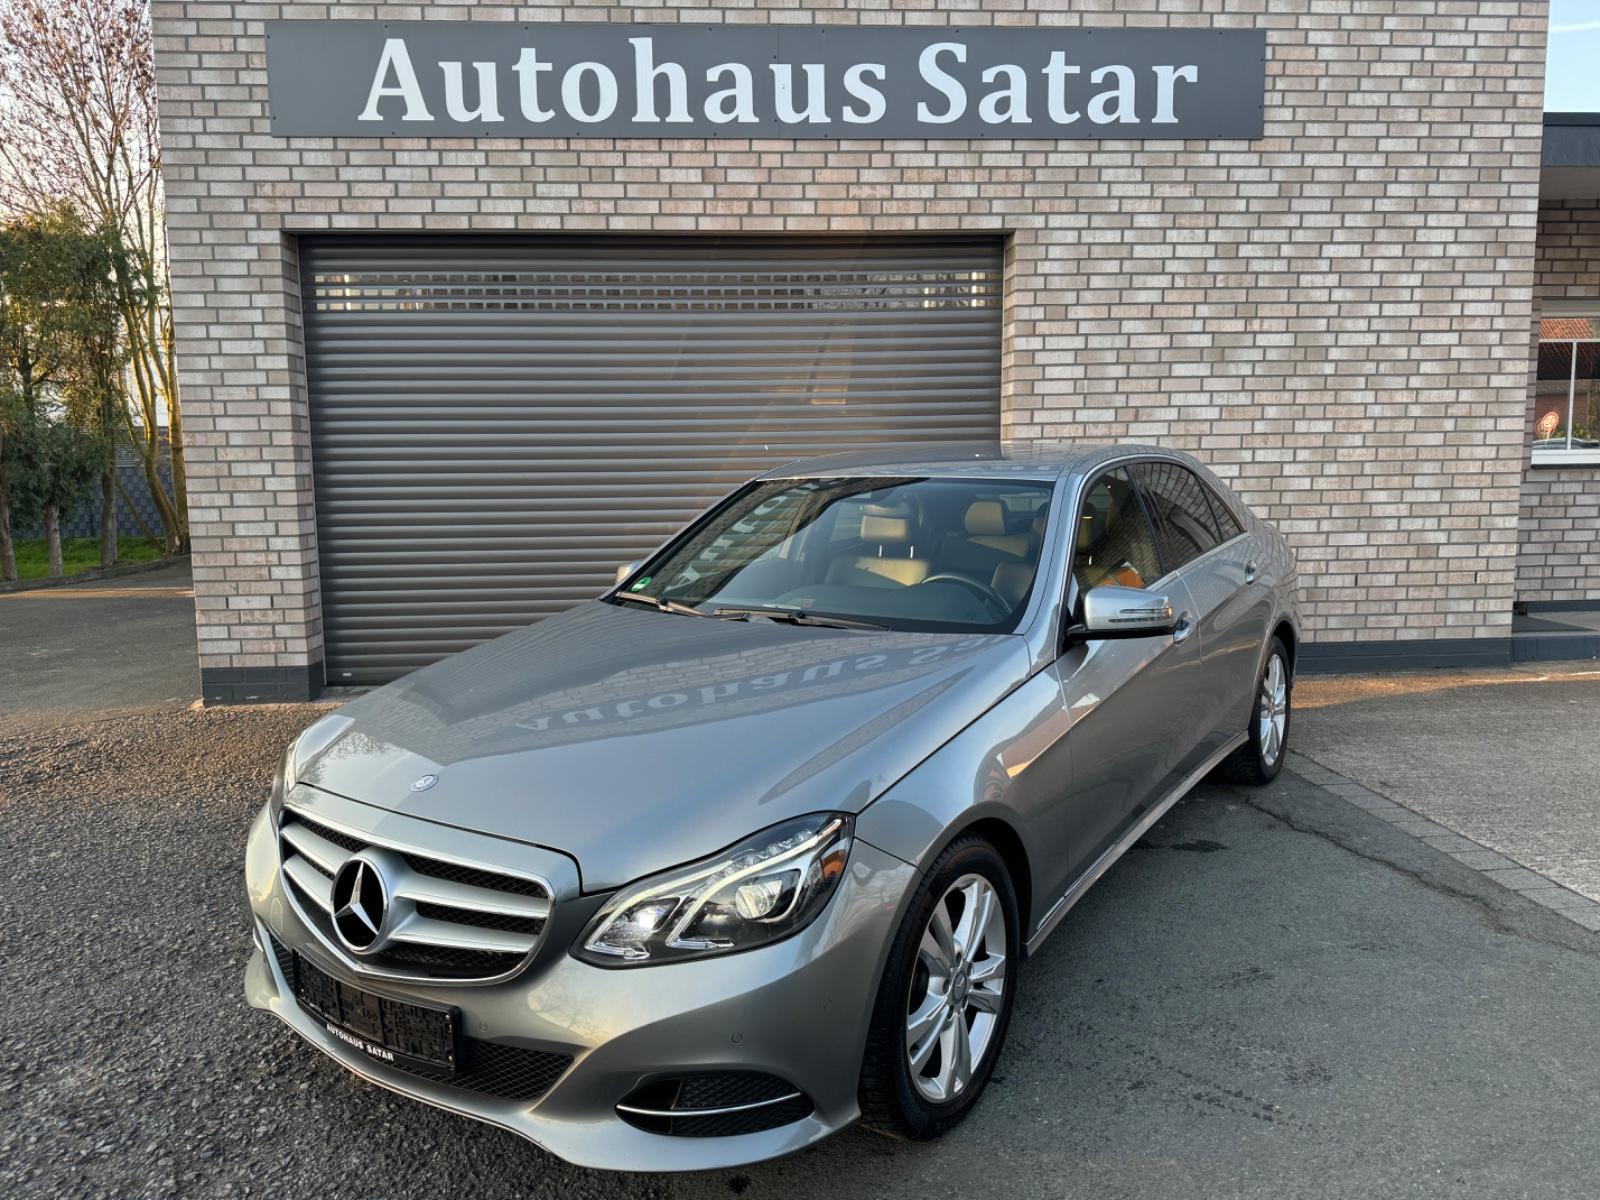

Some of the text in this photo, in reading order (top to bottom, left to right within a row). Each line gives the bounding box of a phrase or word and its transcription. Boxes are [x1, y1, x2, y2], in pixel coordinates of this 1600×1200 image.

[357, 37, 1199, 124] Autohaus Satar
[326, 1023, 394, 1062] AUTOHAUS SATAR
